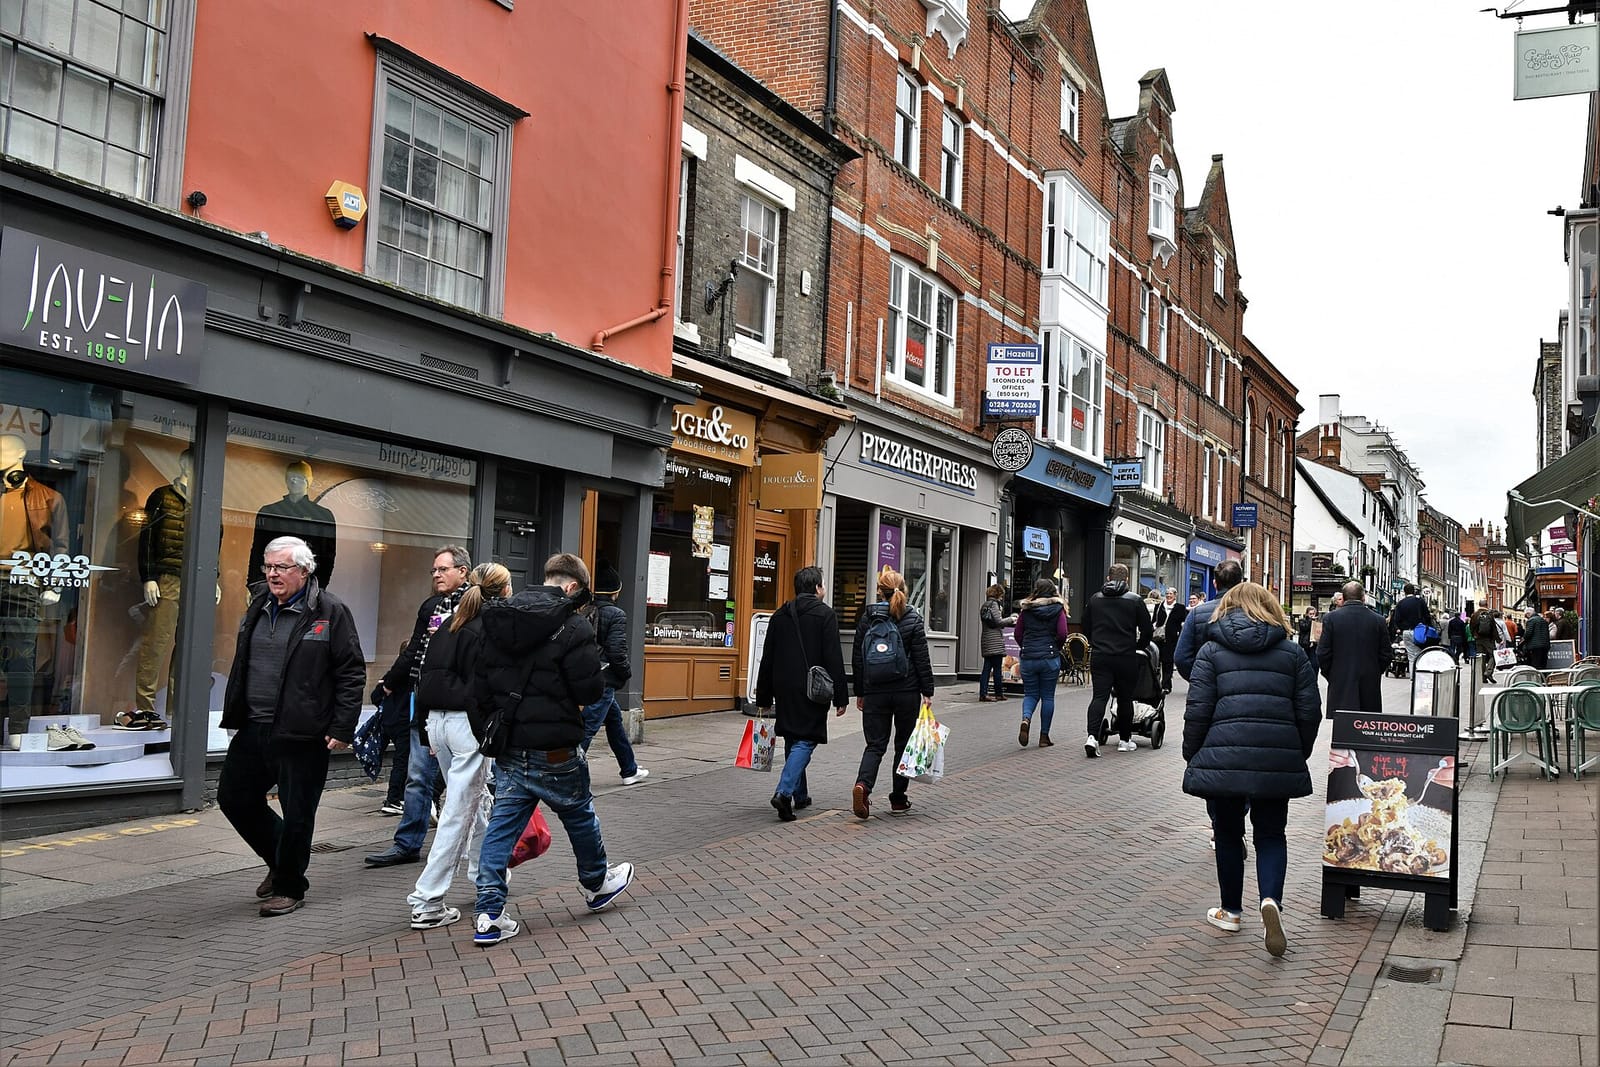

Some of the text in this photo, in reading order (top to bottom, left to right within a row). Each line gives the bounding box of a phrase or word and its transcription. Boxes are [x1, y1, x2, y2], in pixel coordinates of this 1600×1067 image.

[22, 245, 184, 361] JAVELIN
[39, 330, 128, 364] EST. 1989
[1006, 348, 1035, 359] Hazells
[995, 367, 1033, 377] TO LET
[988, 401, 1037, 409] 01284 702626
[720, 447, 741, 460] Pizza
[665, 461, 732, 487] elivery Take-away
[10, 550, 91, 579] 2023
[9, 575, 90, 588] NEW SEASON
[653, 627, 683, 640] Delivery
[1353, 719, 1435, 734] GASTRONOME
[1373, 754, 1391, 766] give
